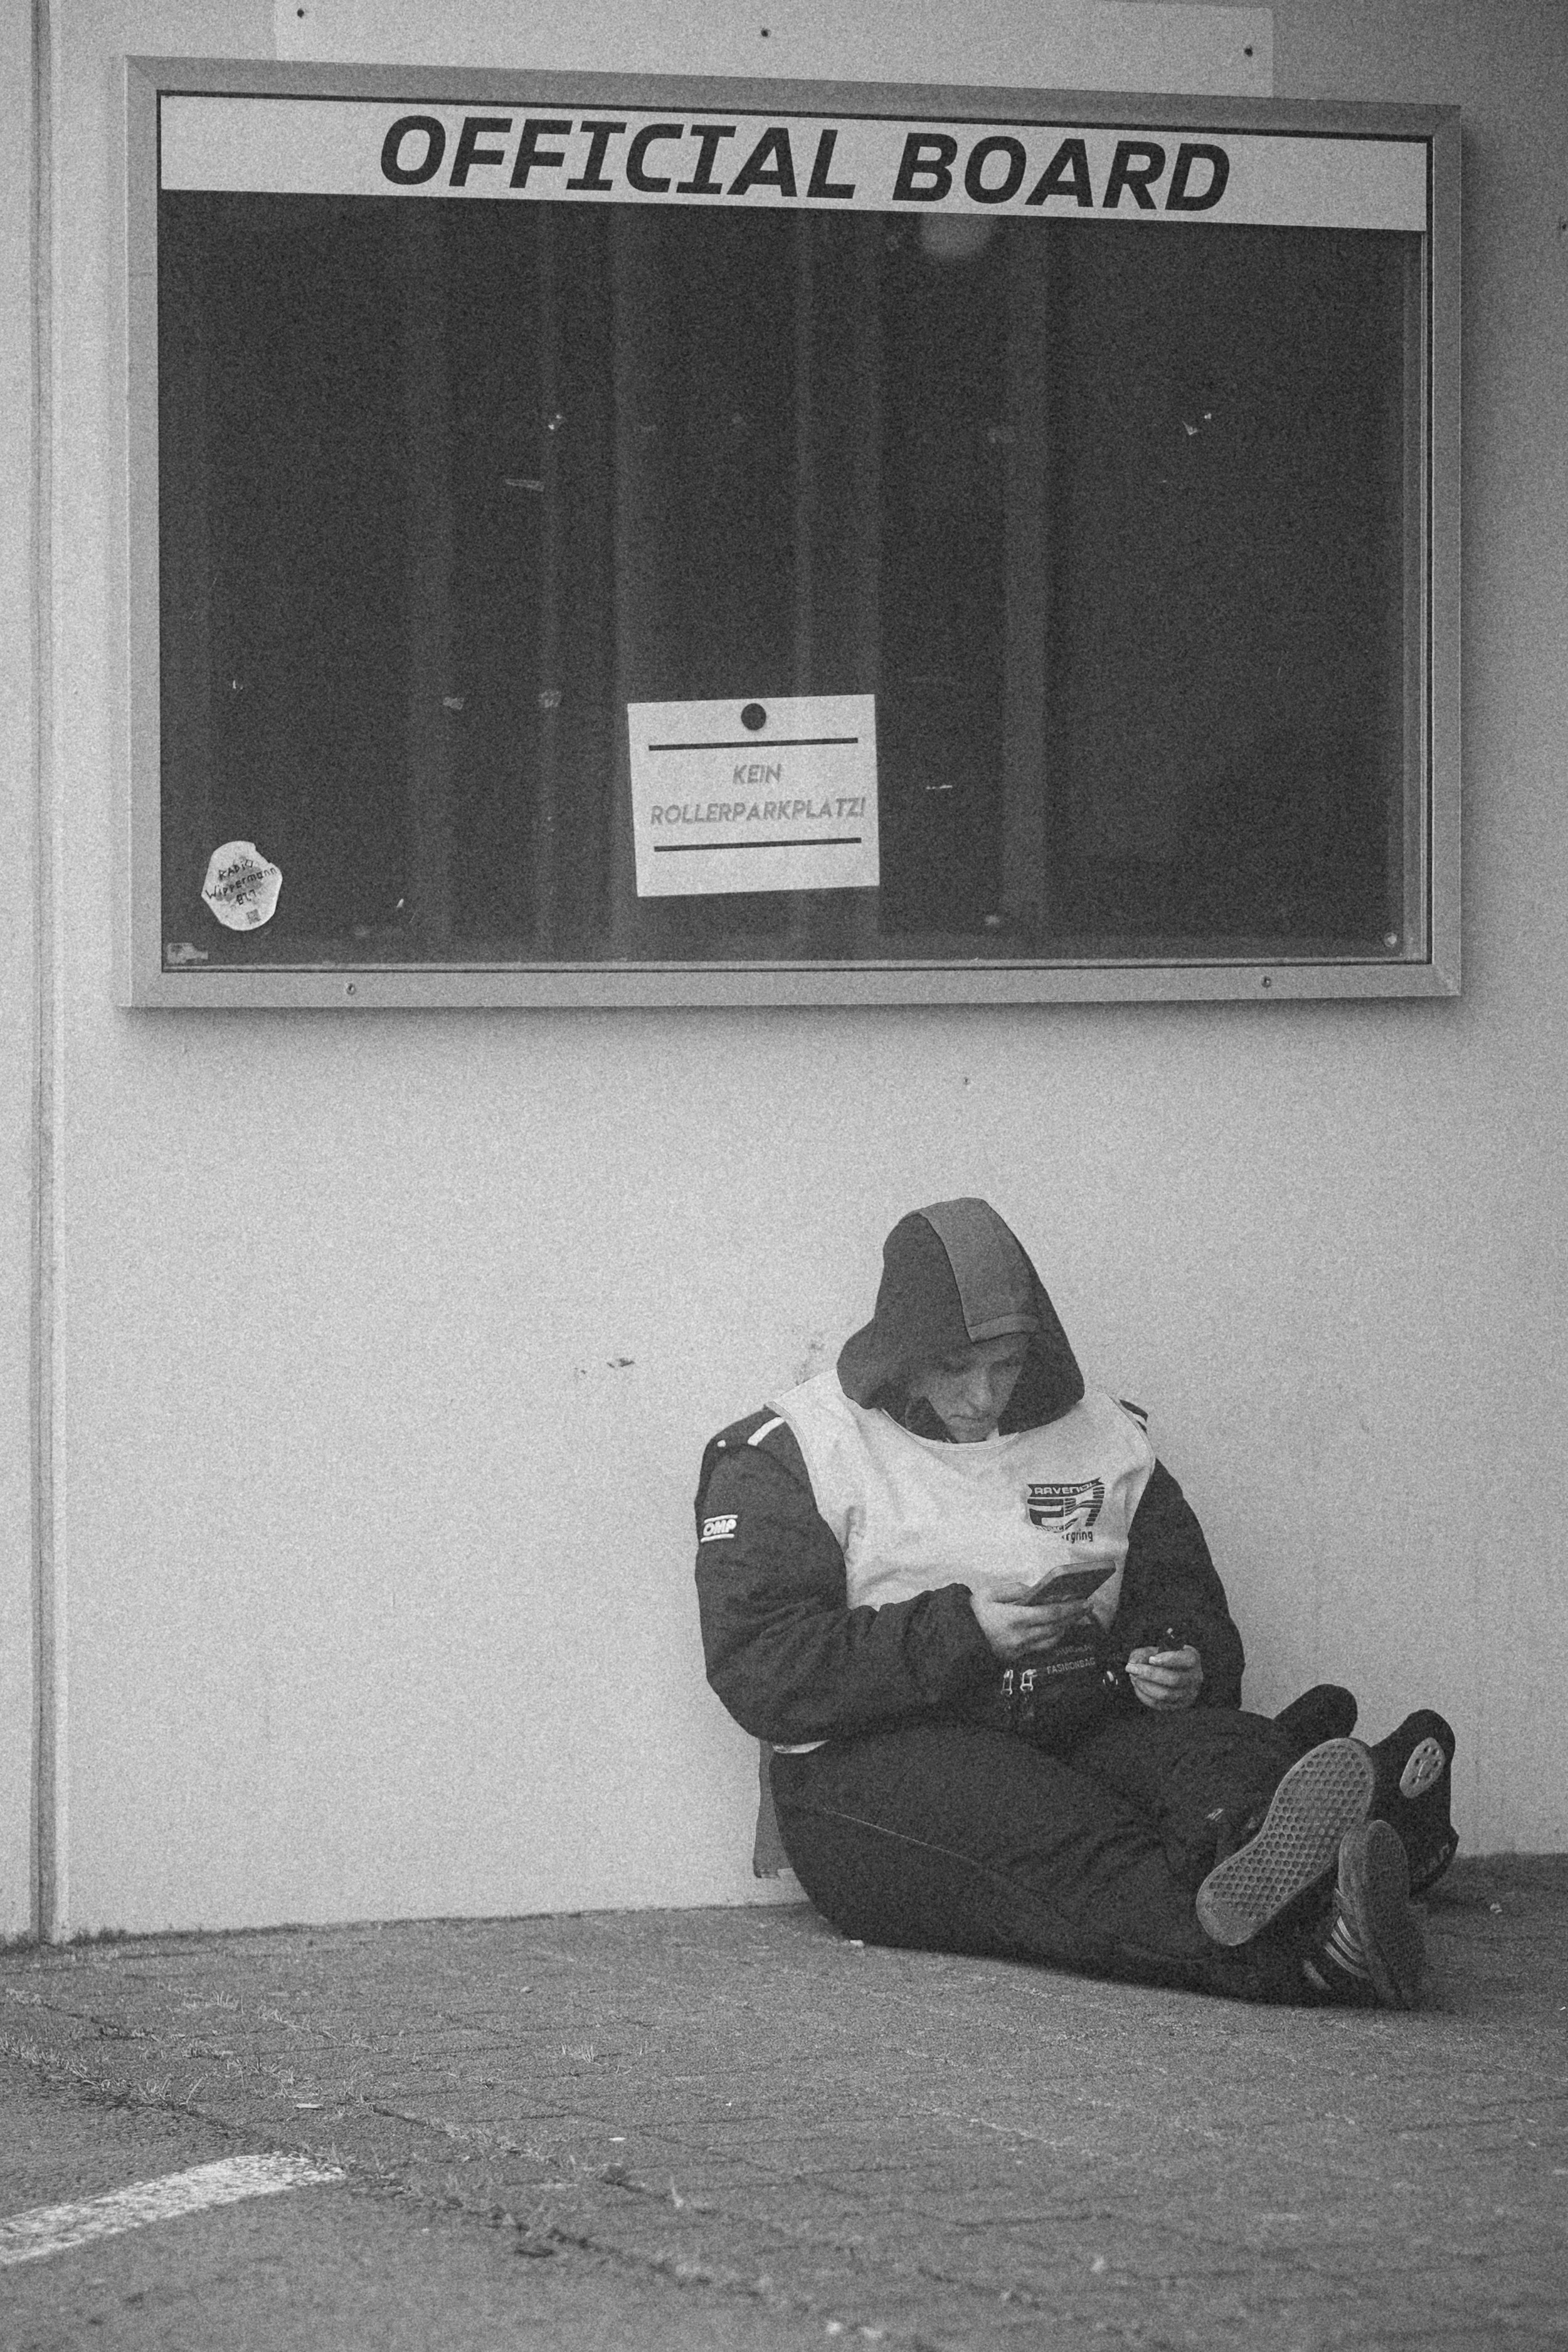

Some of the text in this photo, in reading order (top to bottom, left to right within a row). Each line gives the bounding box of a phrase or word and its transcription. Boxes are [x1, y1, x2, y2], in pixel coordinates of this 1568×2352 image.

[380, 115, 1231, 212] OFFICIAL BOARD
[733, 763, 782, 784] KEIN
[650, 797, 867, 826] ROLLERPARKPLATZ!
[703, 1518, 737, 1537] OMP
